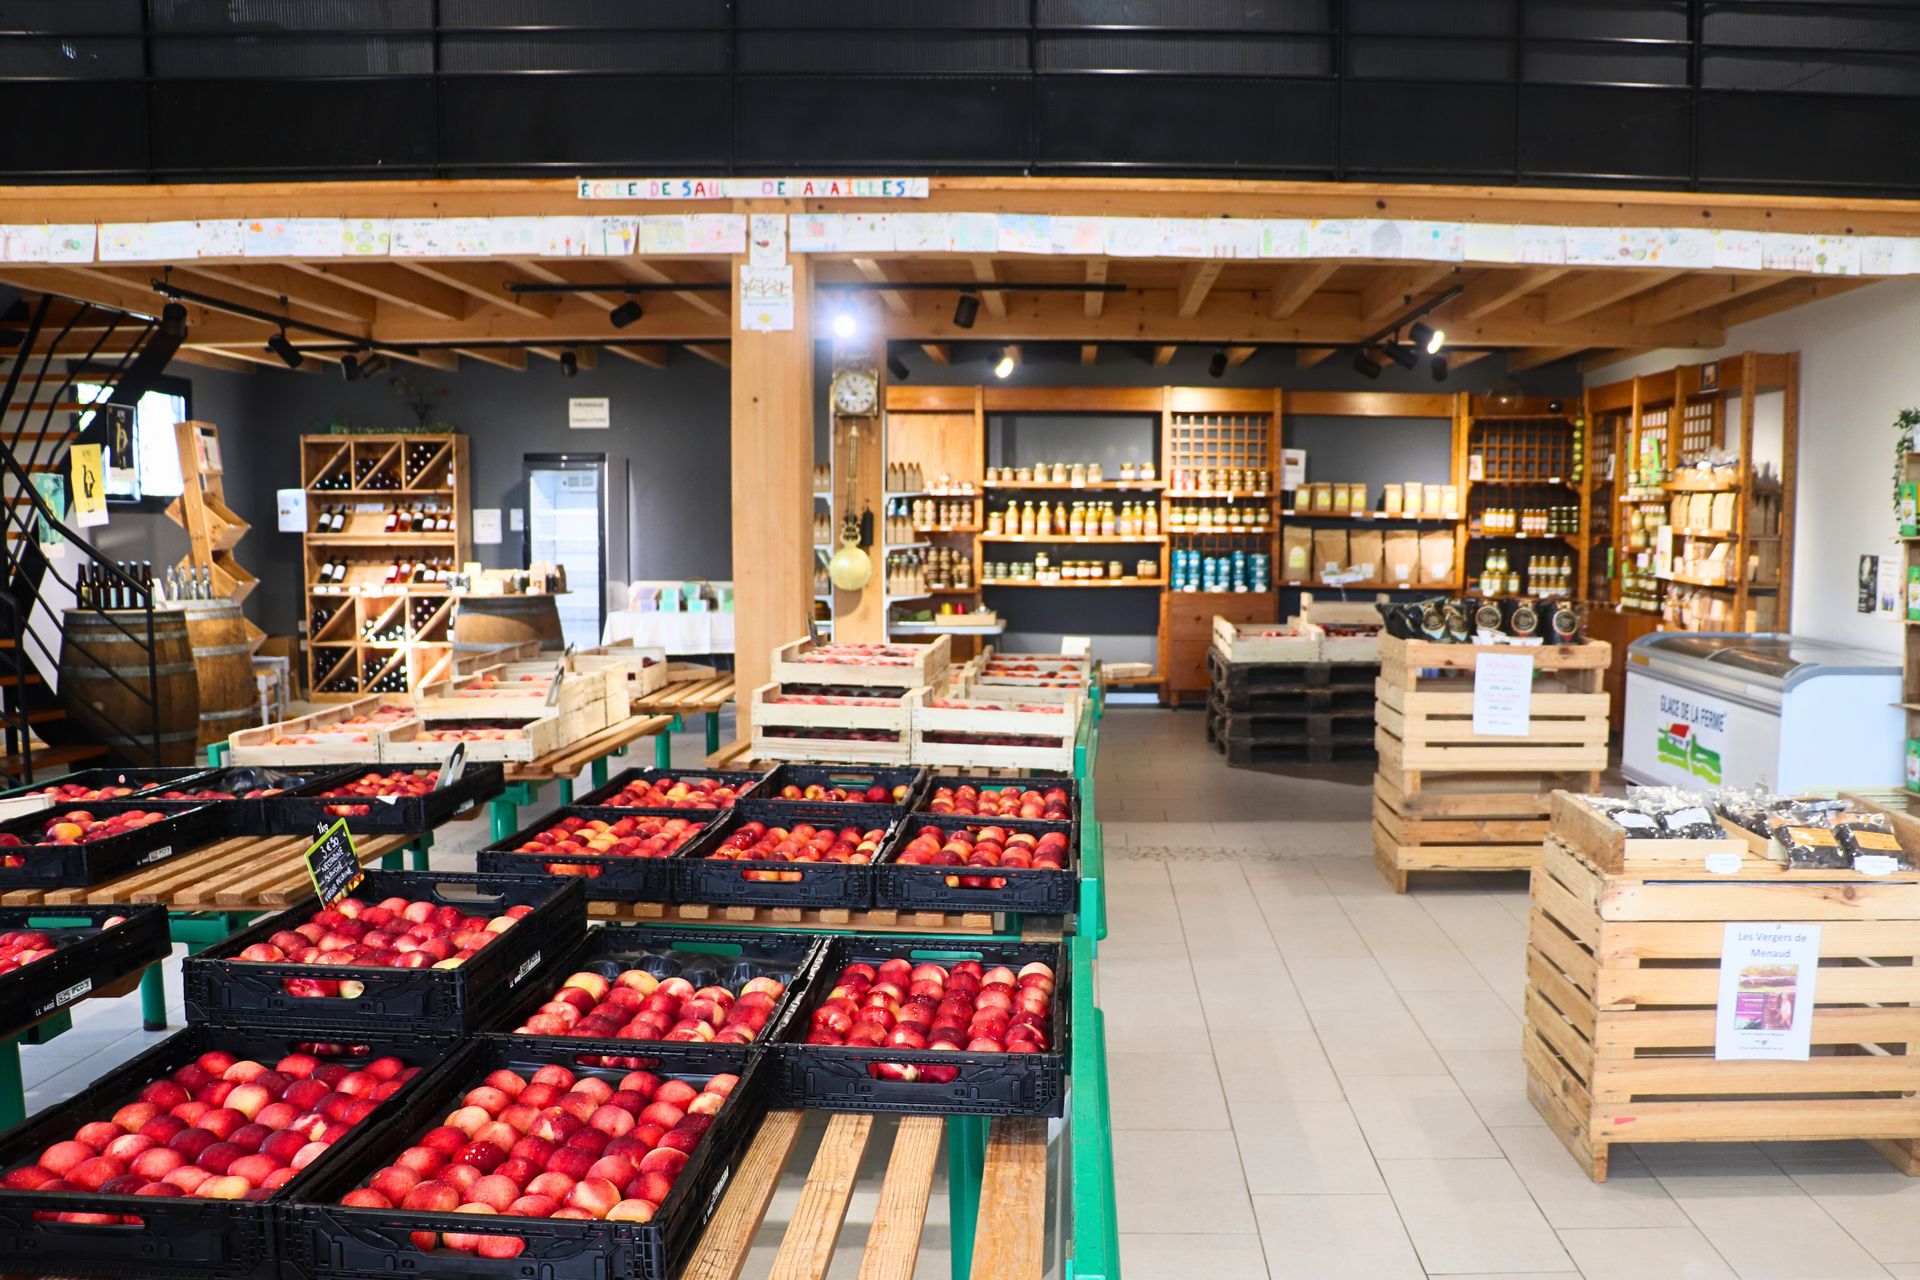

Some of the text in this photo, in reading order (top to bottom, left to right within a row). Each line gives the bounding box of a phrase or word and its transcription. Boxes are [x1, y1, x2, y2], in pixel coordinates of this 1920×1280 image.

[650, 181, 671, 196] DE
[762, 181, 785, 195] DE
[1661, 694, 1724, 733] GLACE DE LA FERME
[1738, 931, 1807, 943] Les Vergers de
[1751, 949, 1791, 958] Menaud
